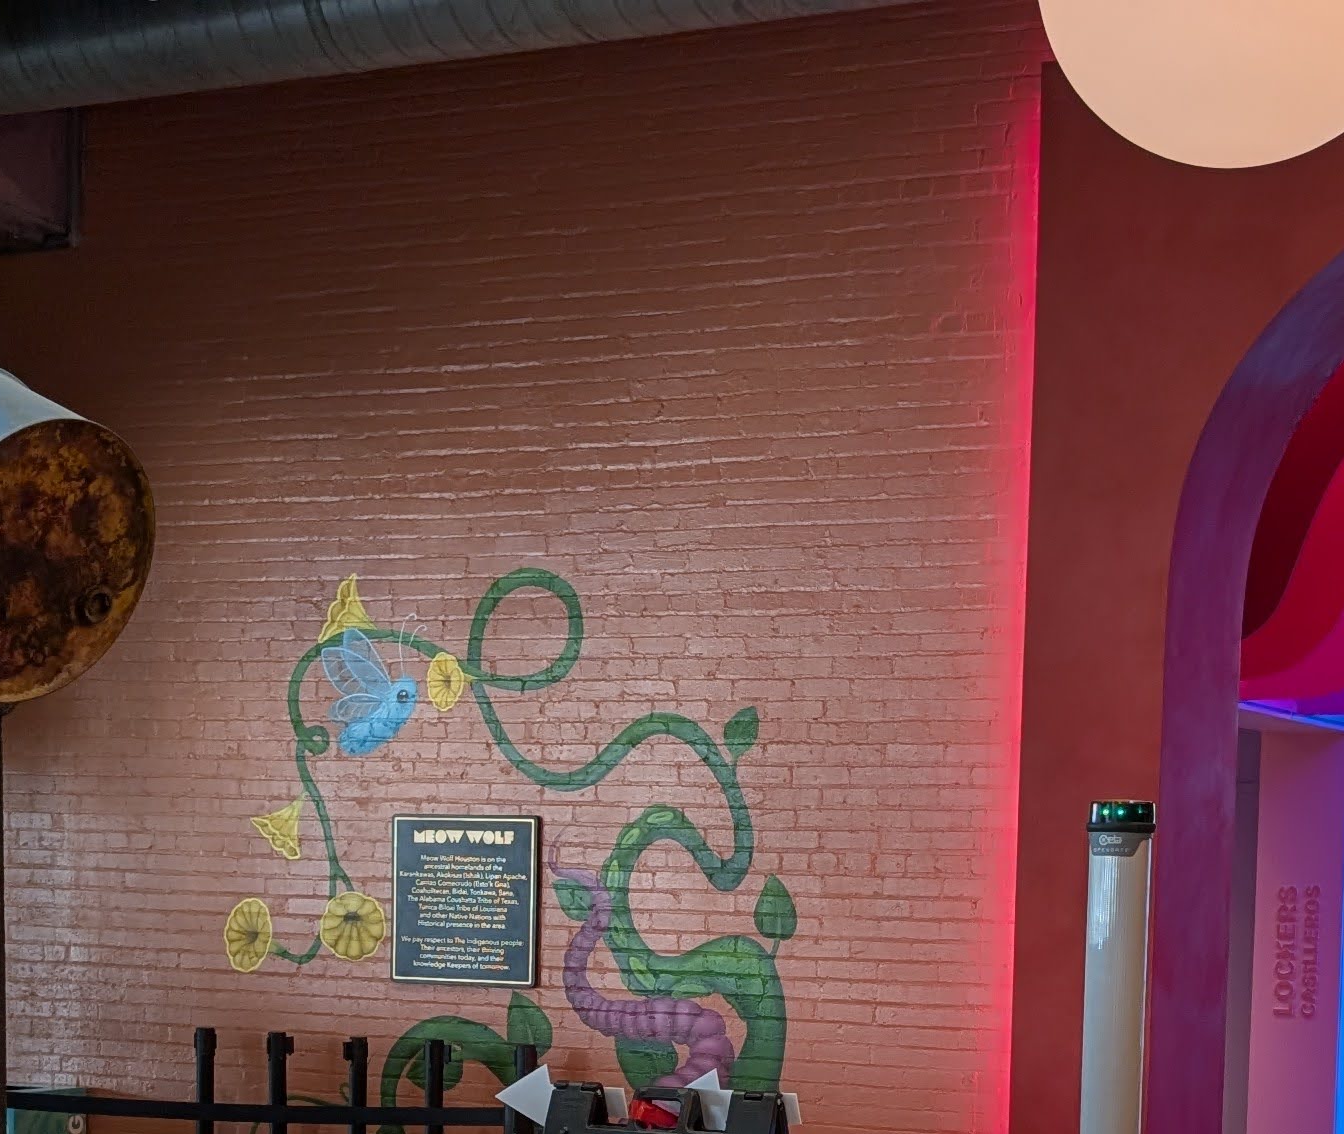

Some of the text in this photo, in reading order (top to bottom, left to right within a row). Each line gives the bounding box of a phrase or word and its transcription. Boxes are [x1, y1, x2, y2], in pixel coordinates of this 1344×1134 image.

[413, 829, 515, 845] MEOW WOLF
[455, 855, 480, 863] Houston
[479, 905, 507, 913] Louisiana
[449, 912, 468, 920] Native
[412, 936, 423, 944] pay
[466, 937, 500, 946] Indigenous
[436, 945, 466, 953] ancestors,
[481, 947, 505, 955] thriving
[1273, 885, 1298, 1018] LOCKERS
[1300, 885, 1321, 1019] CASILLEROS
[413, 960, 446, 968] knowledge
[447, 961, 471, 969] Keepers
